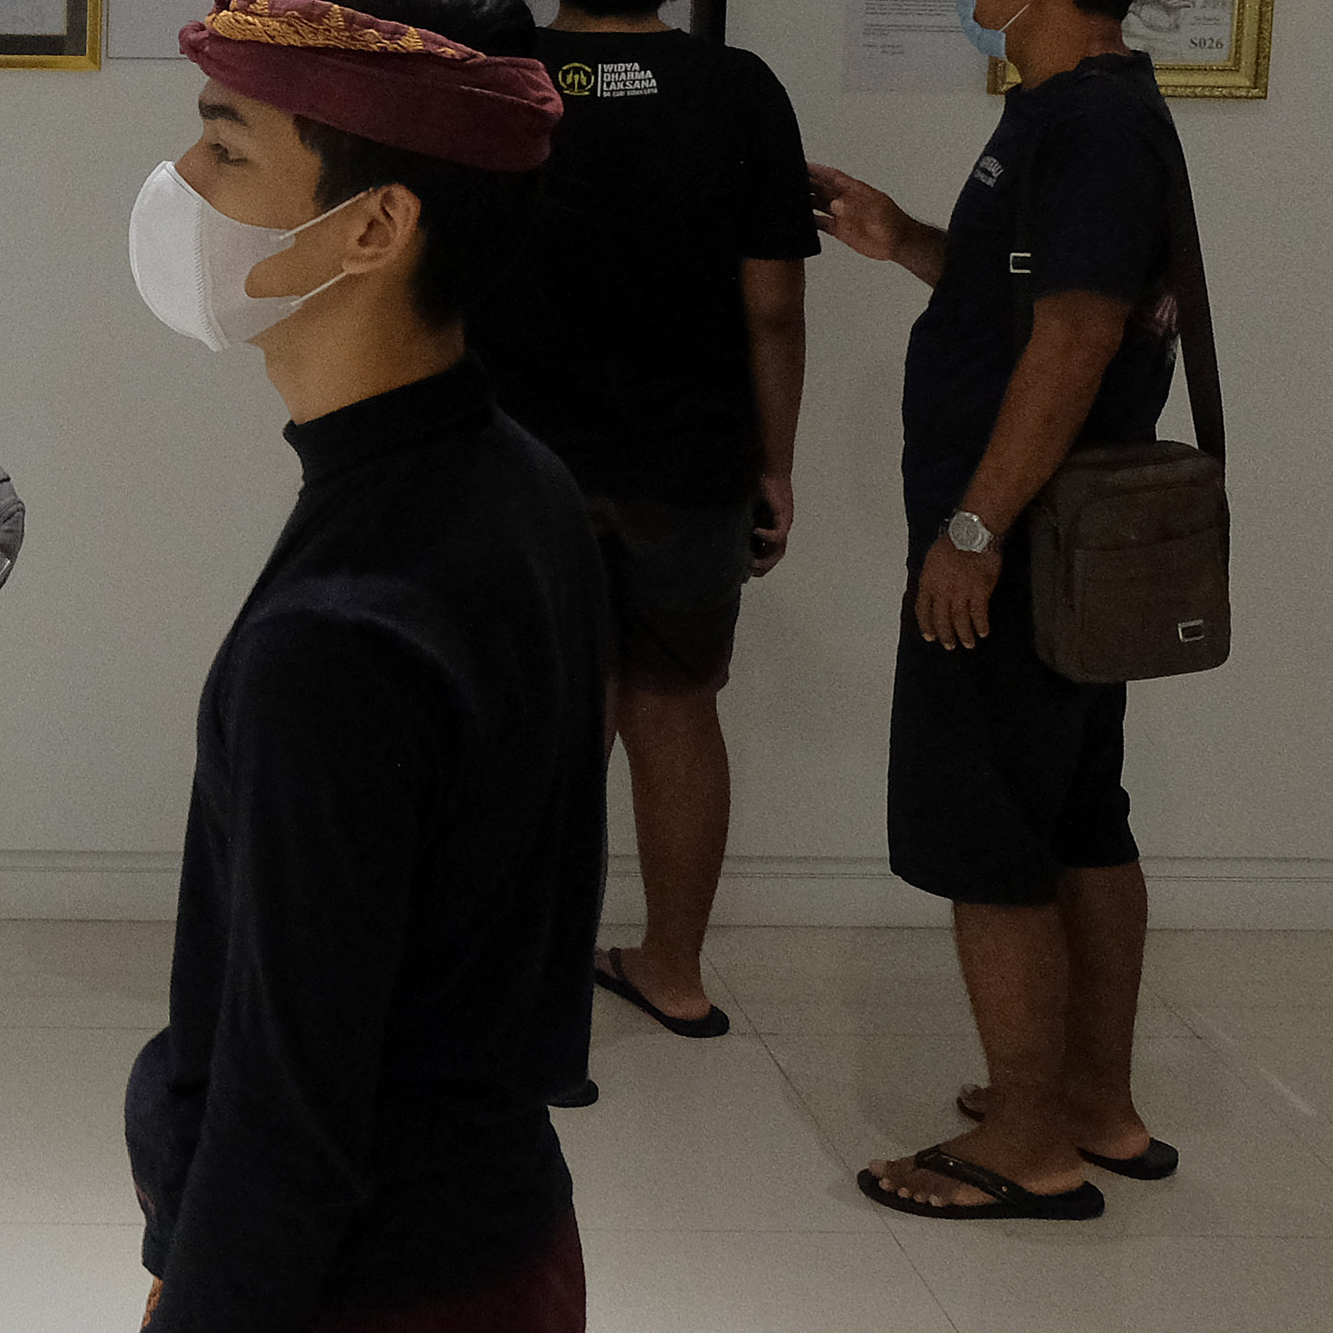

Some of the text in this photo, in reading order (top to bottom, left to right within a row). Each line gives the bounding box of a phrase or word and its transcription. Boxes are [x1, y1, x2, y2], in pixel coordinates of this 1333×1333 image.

[1189, 36, 1224, 50] S026
[603, 62, 640, 73] WIDYA
[603, 79, 658, 91] LAKSANA
